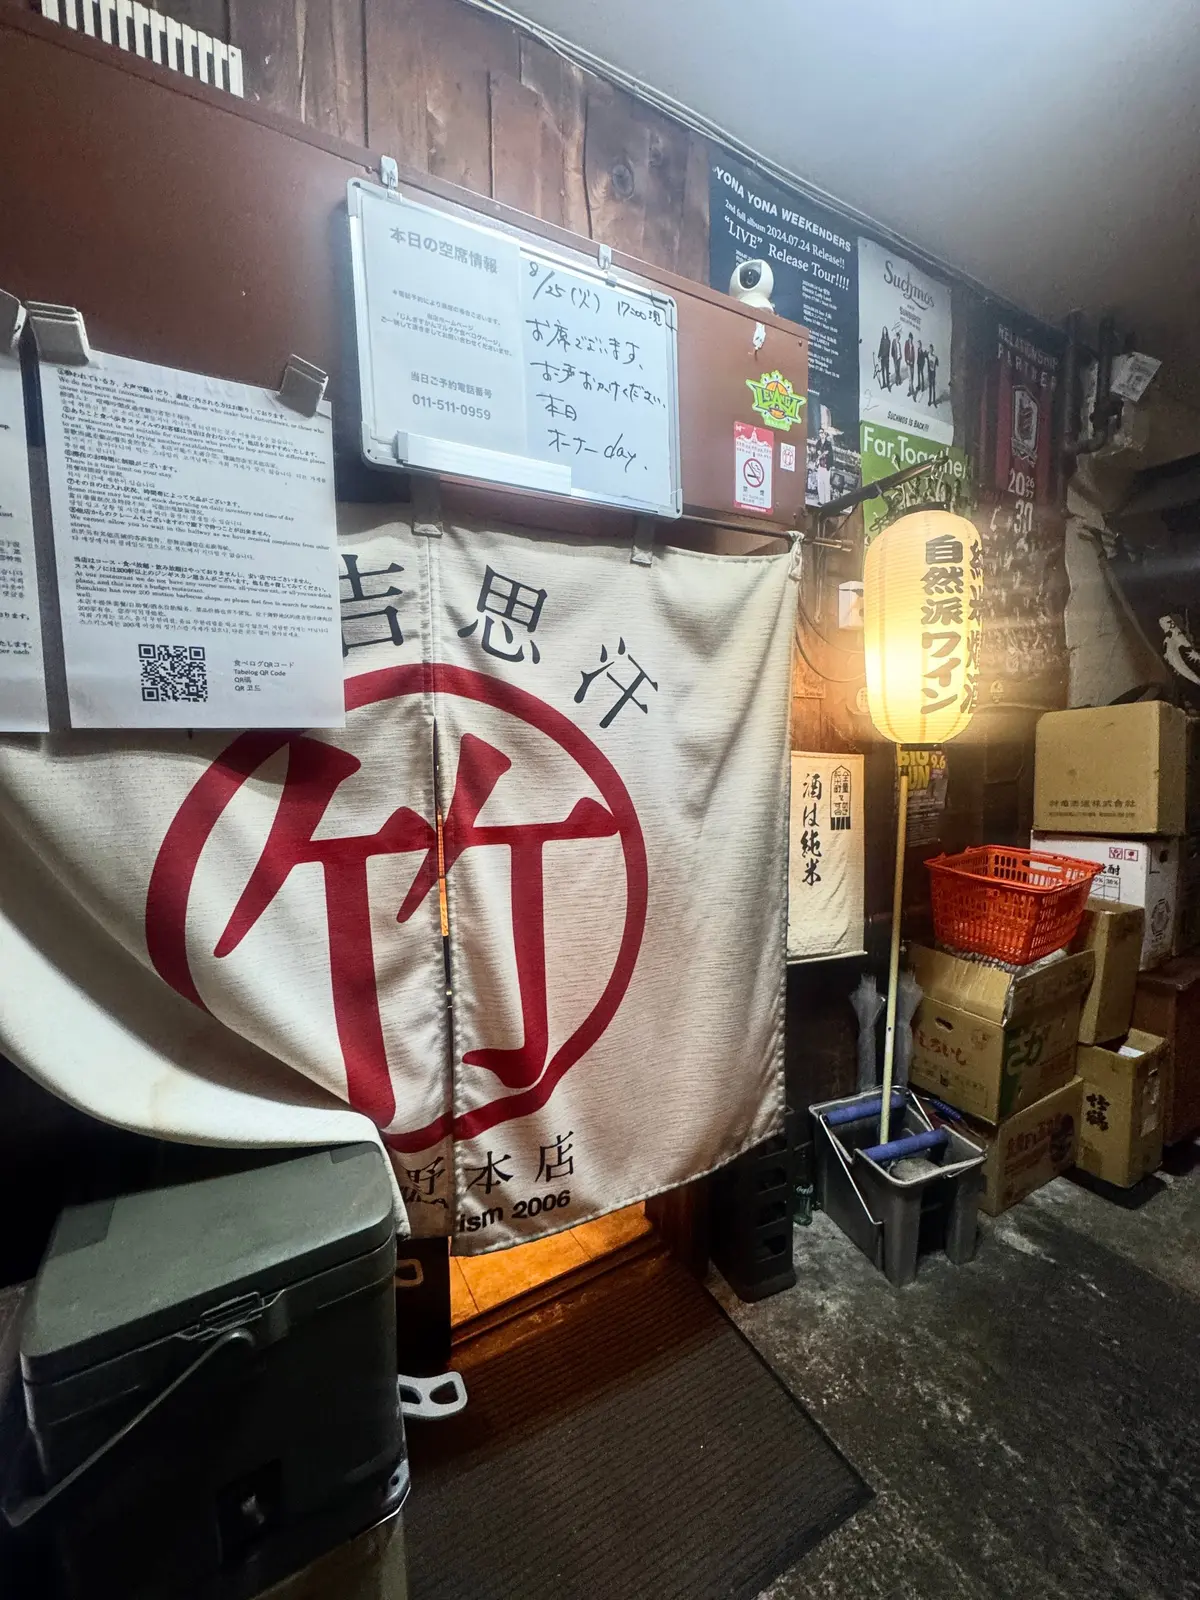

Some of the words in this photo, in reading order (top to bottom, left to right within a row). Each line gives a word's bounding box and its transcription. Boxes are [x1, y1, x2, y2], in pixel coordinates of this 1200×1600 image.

[714, 167, 745, 198] YONA
[747, 192, 778, 216] YONA
[781, 208, 851, 252] WEEKENDERS
[725, 199, 736, 214] 2nd
[747, 213, 766, 232] album
[766, 224, 811, 253] 2024.07.24
[390, 227, 498, 274] 本日の空席情報
[768, 243, 809, 272] Release
[811, 262, 850, 291] Tour!!!!
[883, 260, 935, 311] Suchmos
[411, 371, 492, 399] 当日ご予約電話番号
[412, 393, 491, 420] 011-511-0959
[536, 394, 577, 421] 本日
[863, 426, 895, 458] Far
[920, 535, 964, 714] 自然派ワイン
[233, 659, 295, 669] 食べログQRコード
[800, 772, 823, 887] 酒は純米
[512, 1189, 571, 1220] 2006
